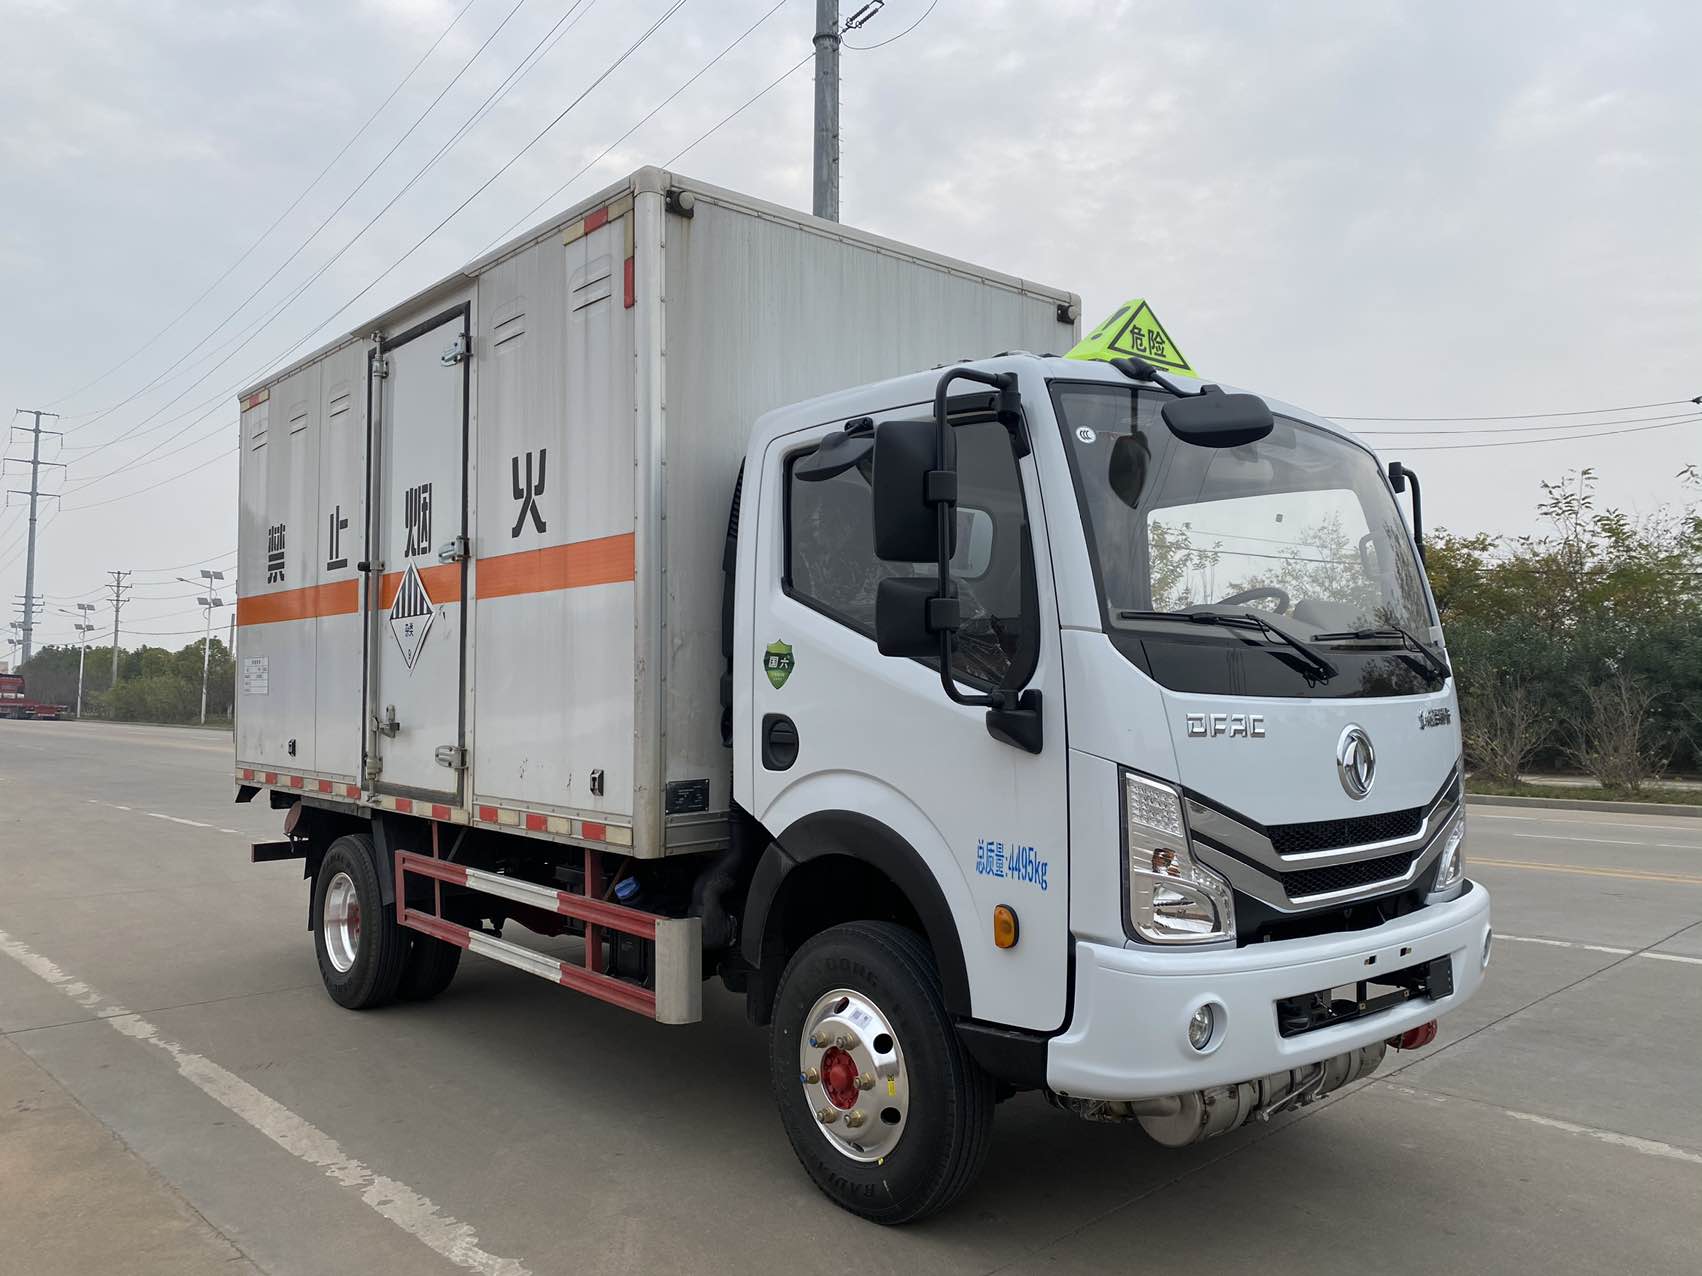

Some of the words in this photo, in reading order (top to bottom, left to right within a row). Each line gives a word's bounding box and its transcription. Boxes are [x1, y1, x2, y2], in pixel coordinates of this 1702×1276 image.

[1129, 324, 1167, 358] 危险
[769, 656, 789, 668] 国六
[1186, 713, 1266, 738] DFAC
